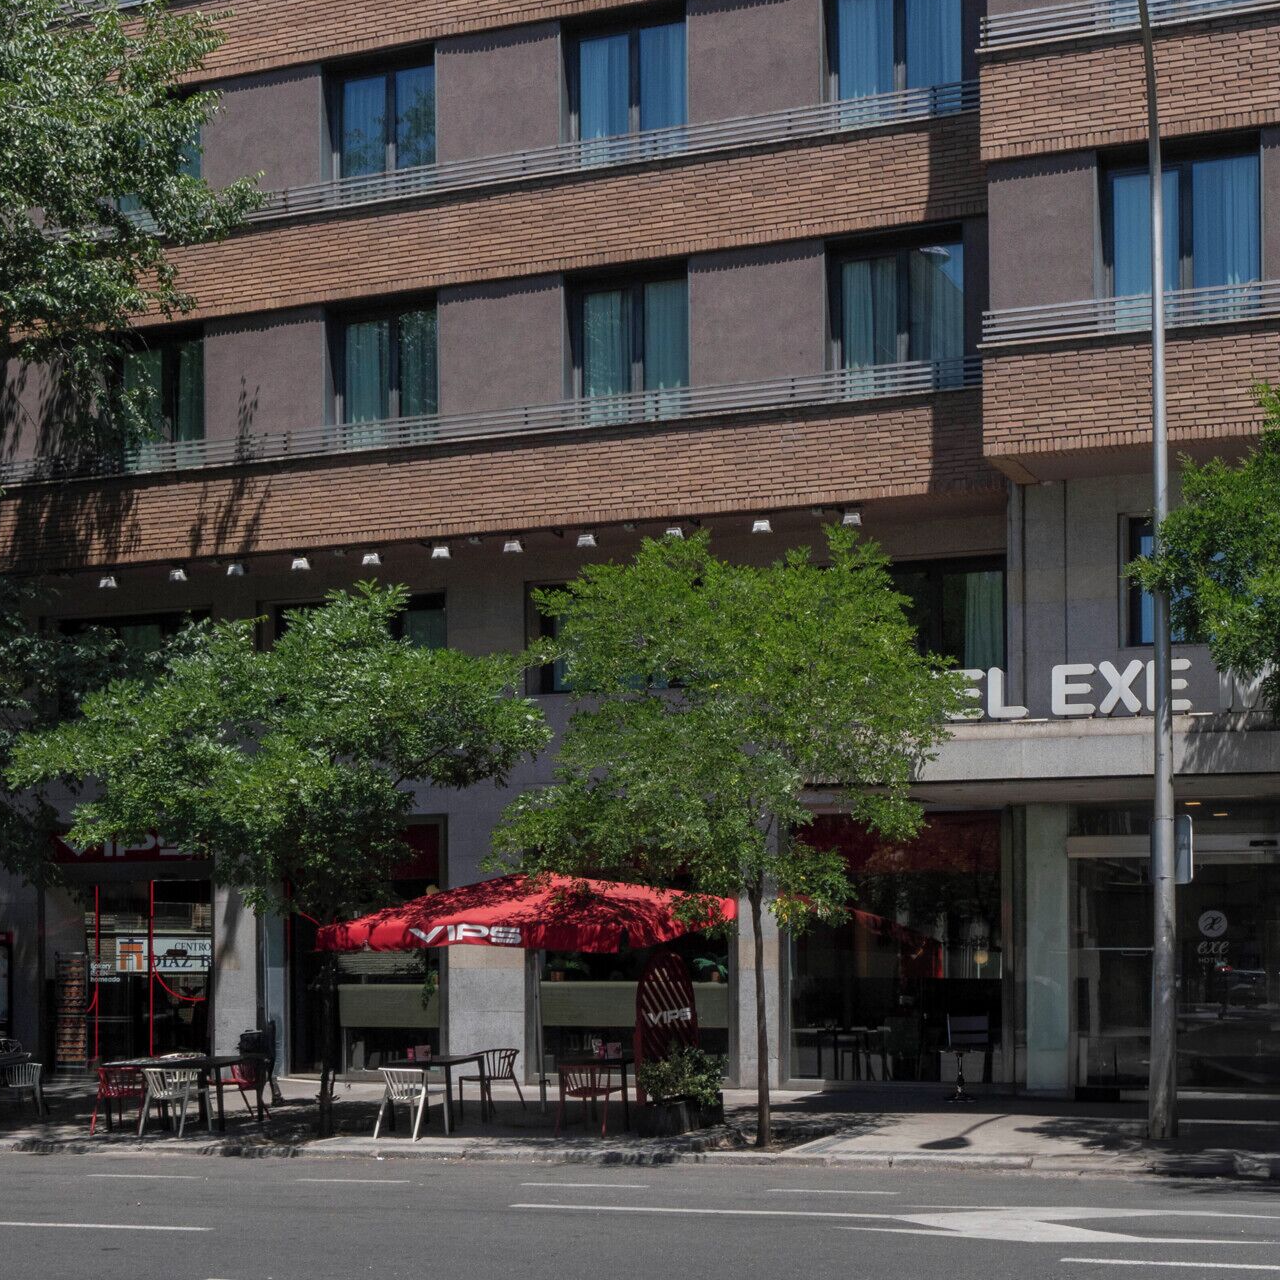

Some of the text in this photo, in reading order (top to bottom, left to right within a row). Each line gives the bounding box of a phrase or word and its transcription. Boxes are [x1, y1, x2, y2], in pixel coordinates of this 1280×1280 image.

[1051, 658, 1193, 716] EXE
[408, 923, 523, 944] VIPS
[1197, 941, 1230, 955] exe
[648, 1007, 692, 1025] VIPS
